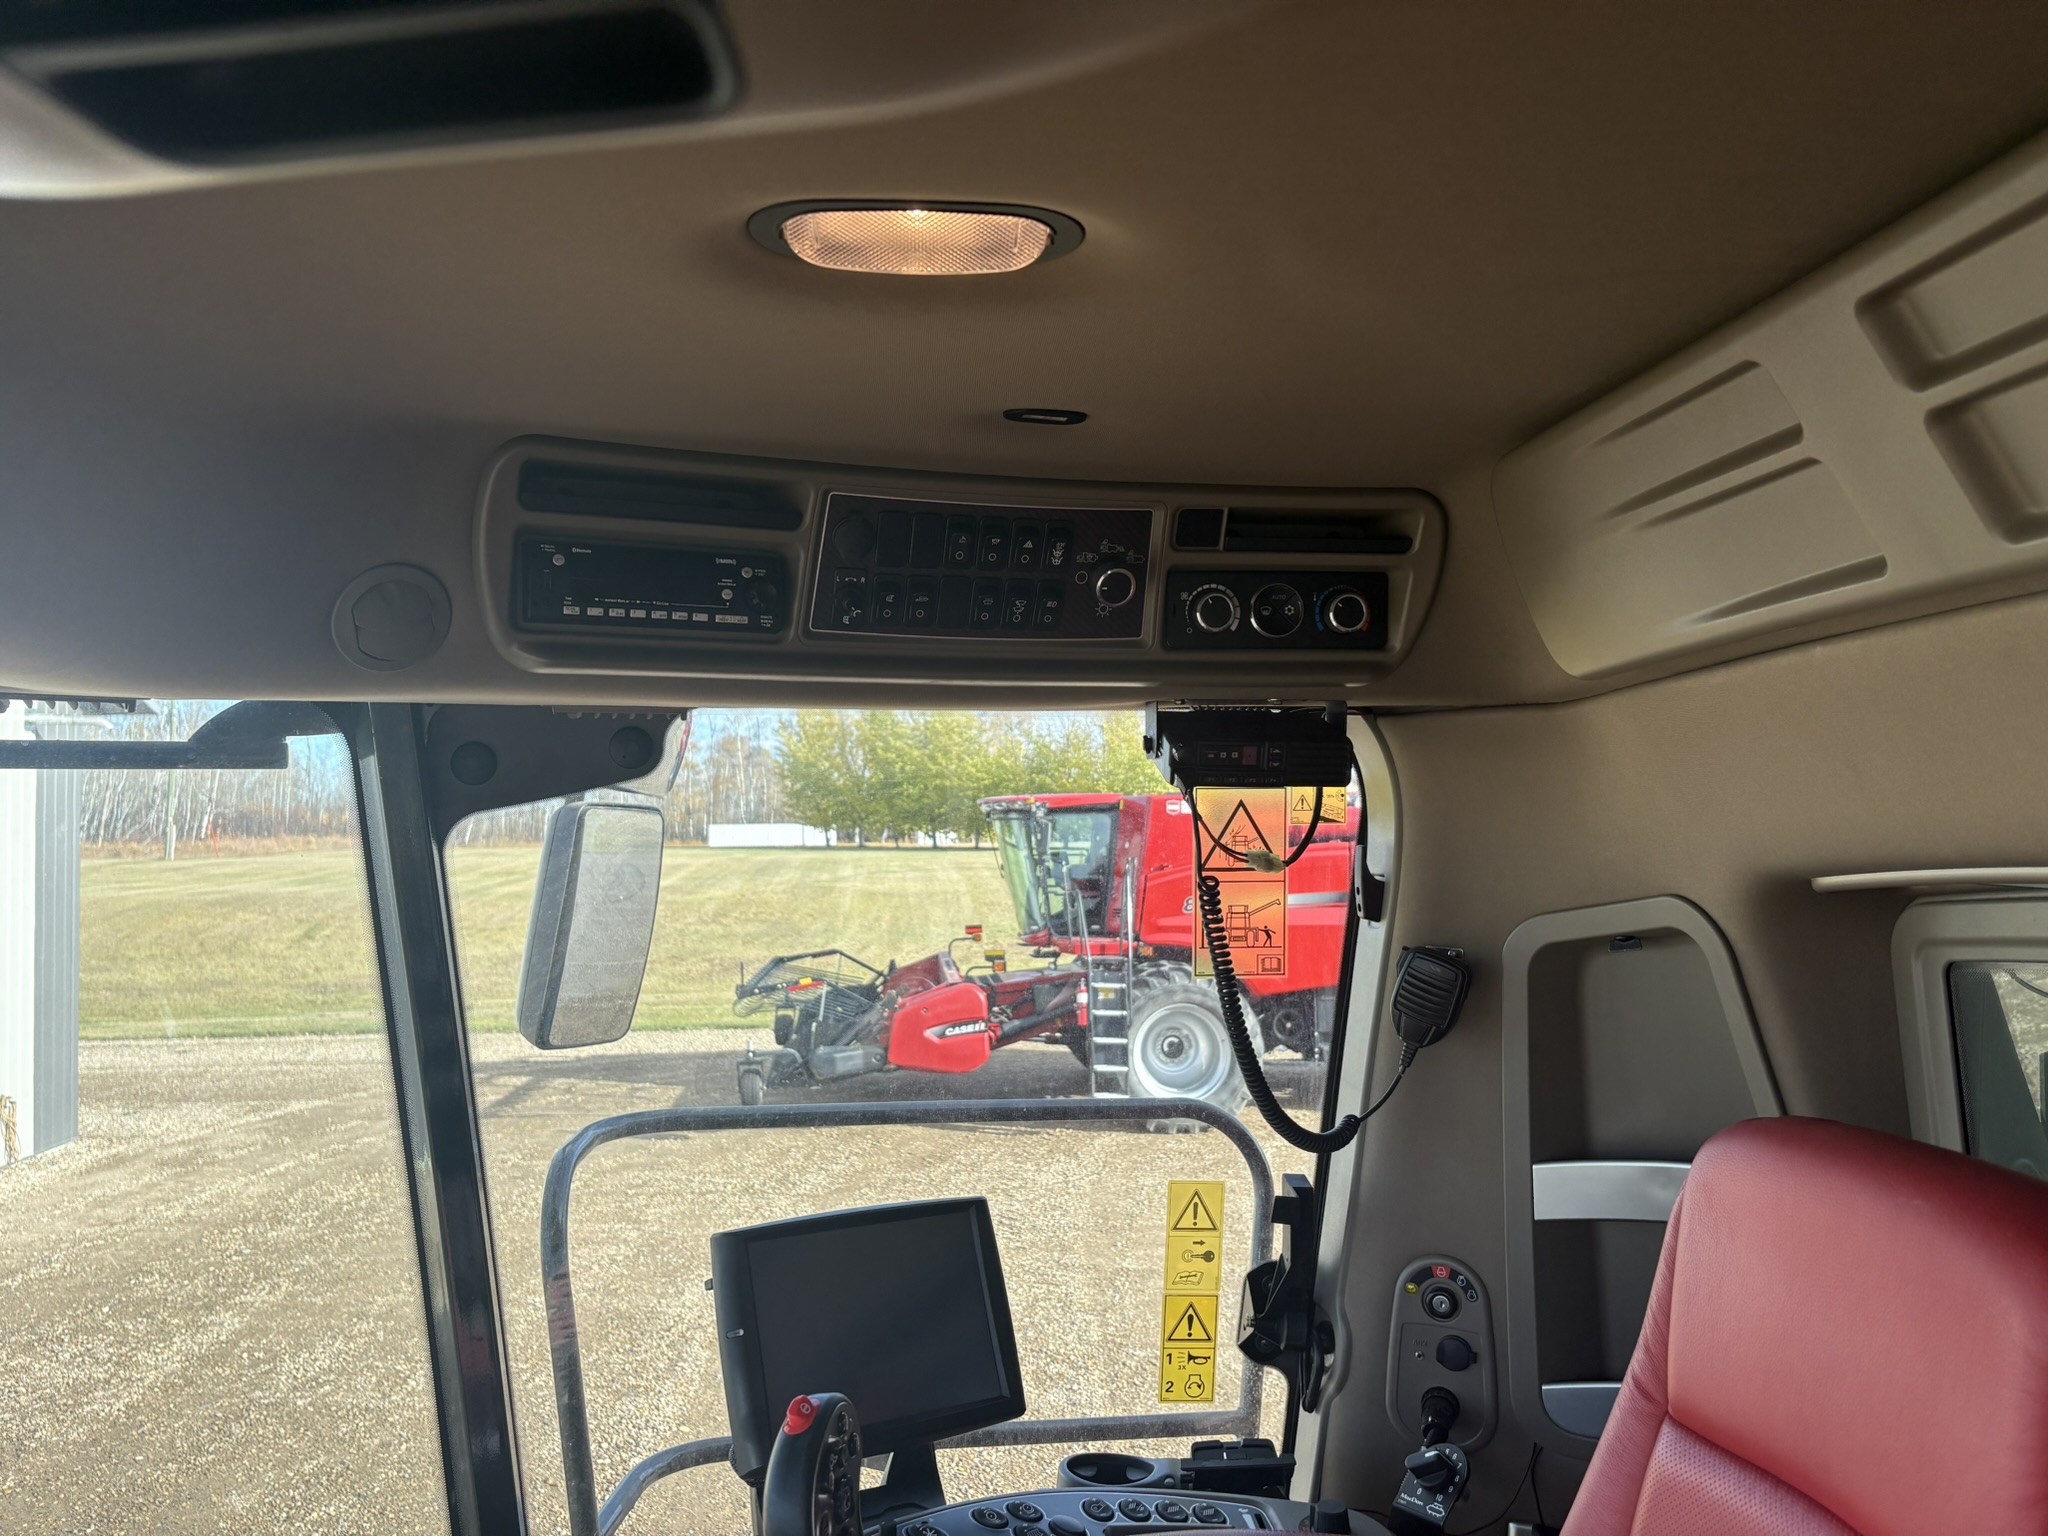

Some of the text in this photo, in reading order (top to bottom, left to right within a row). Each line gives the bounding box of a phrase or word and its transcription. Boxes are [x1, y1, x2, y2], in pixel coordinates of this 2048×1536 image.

[1166, 1353, 1173, 1365] 1
[1165, 1380, 1174, 1393] 2
[1454, 1475, 1460, 1483] 8
[1416, 1487, 1422, 1495] 0
[1447, 1485, 1454, 1493] 9
[1399, 1492, 1424, 1506] MacDon
[1435, 1493, 1444, 1502] 10
